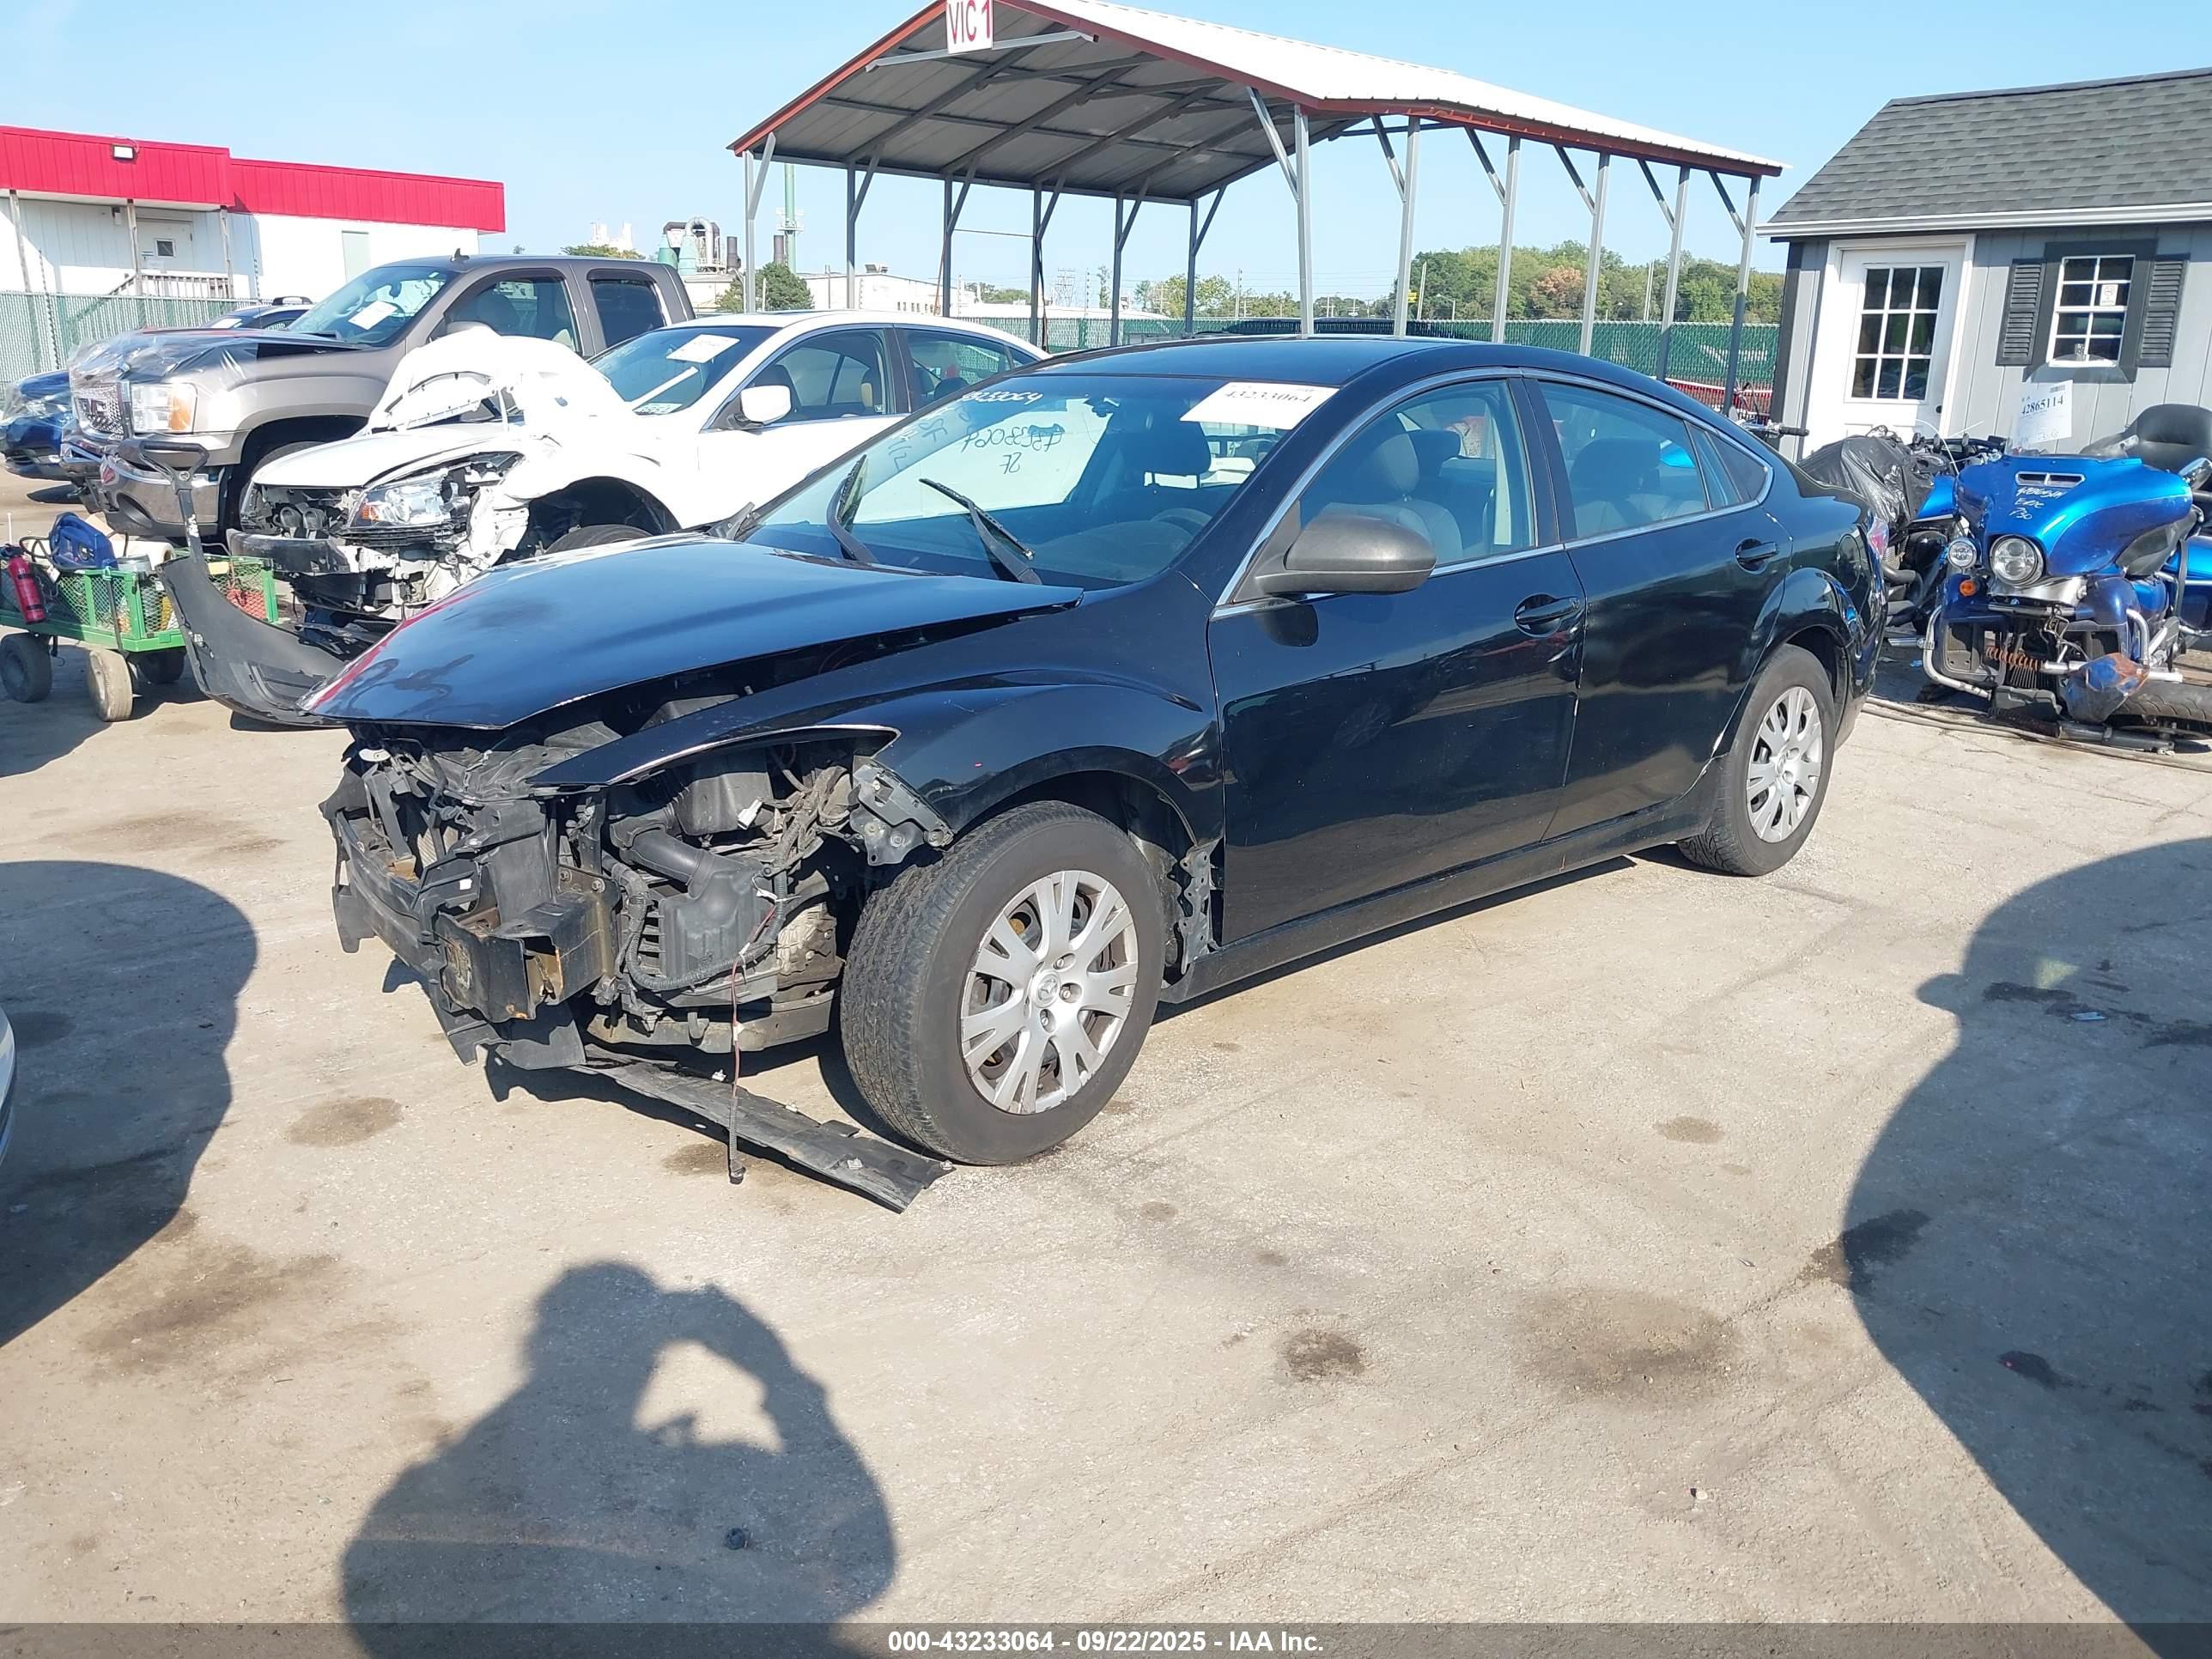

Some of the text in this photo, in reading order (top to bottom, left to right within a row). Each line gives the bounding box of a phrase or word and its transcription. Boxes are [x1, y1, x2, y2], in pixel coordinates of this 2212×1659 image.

[948, 0, 990, 45] VIC 1
[1224, 390, 1312, 403] 43233064
[2021, 394, 2063, 416] 42865114
